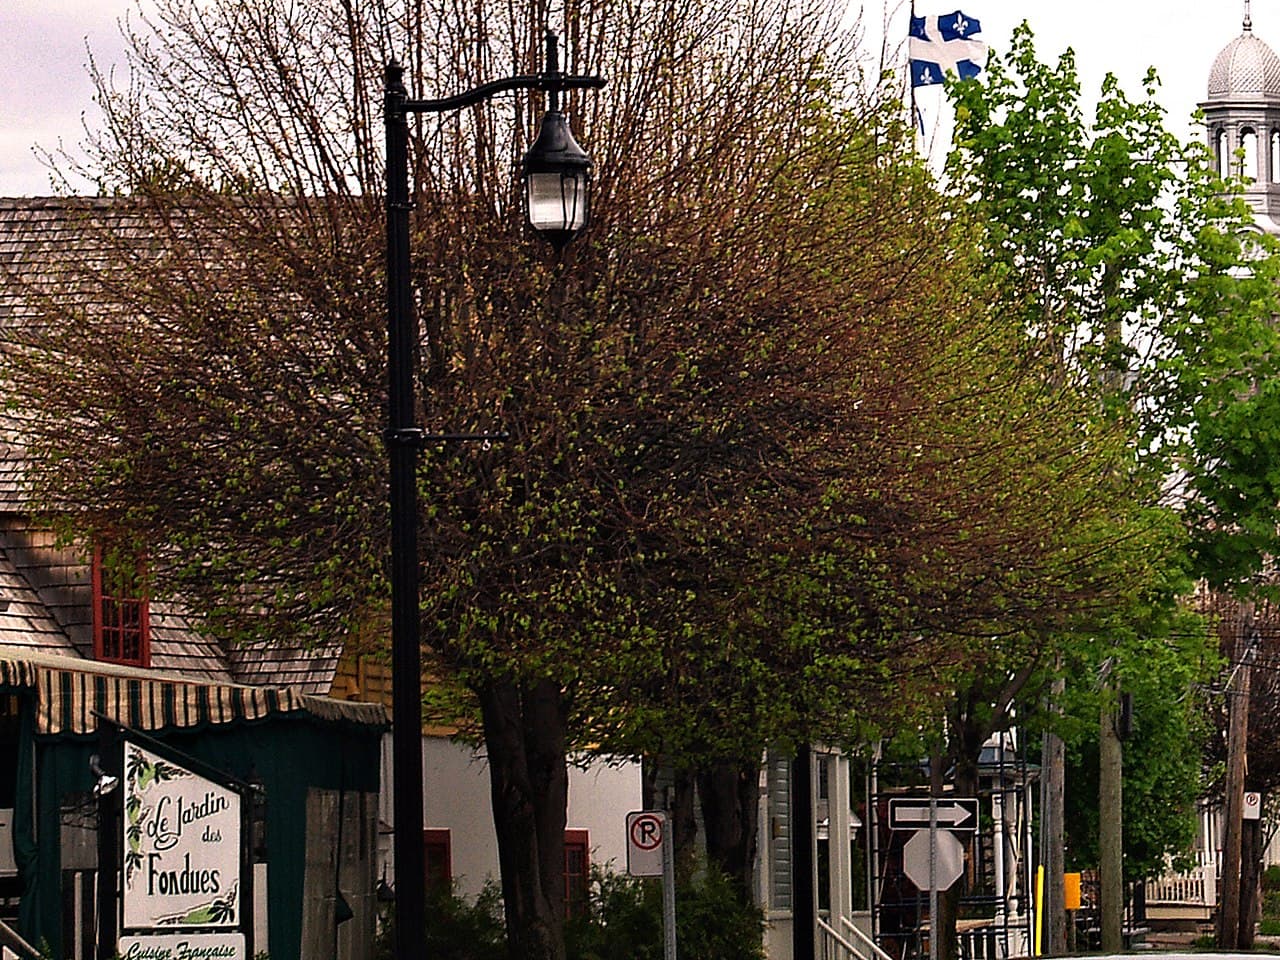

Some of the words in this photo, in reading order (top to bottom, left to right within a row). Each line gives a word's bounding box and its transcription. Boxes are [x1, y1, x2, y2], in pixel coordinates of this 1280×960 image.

[167, 792, 230, 842] Jardin
[202, 825, 222, 843] des
[147, 852, 220, 896] Fondues
[126, 942, 172, 960] Cuisine
